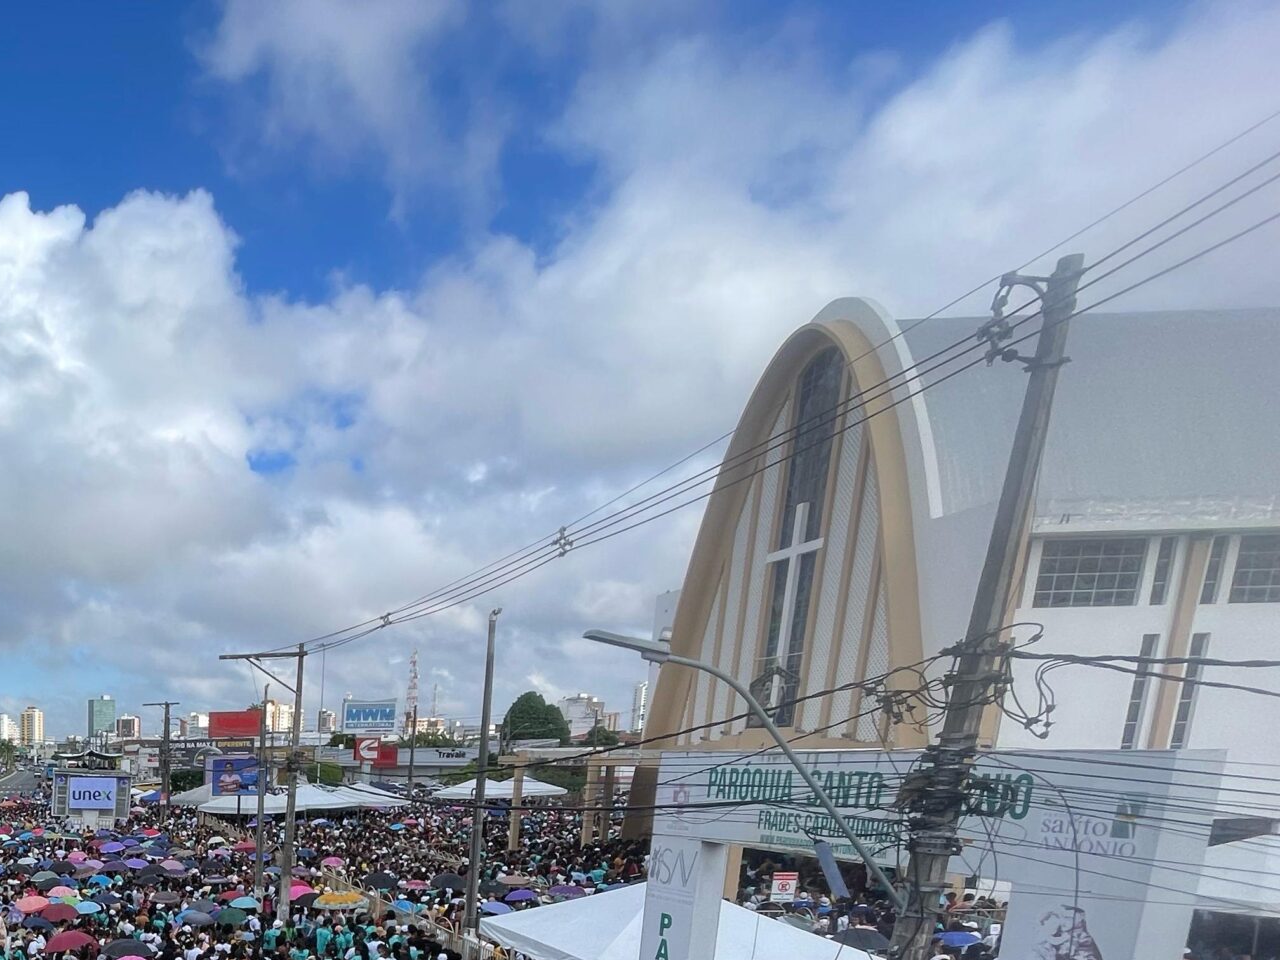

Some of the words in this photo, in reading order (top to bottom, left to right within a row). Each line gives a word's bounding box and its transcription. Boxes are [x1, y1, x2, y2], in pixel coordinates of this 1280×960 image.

[346, 708, 396, 721] MWM
[706, 761, 793, 802] PARÓQUIA
[72, 789, 113, 802] unex
[758, 810, 801, 835] FRADES
